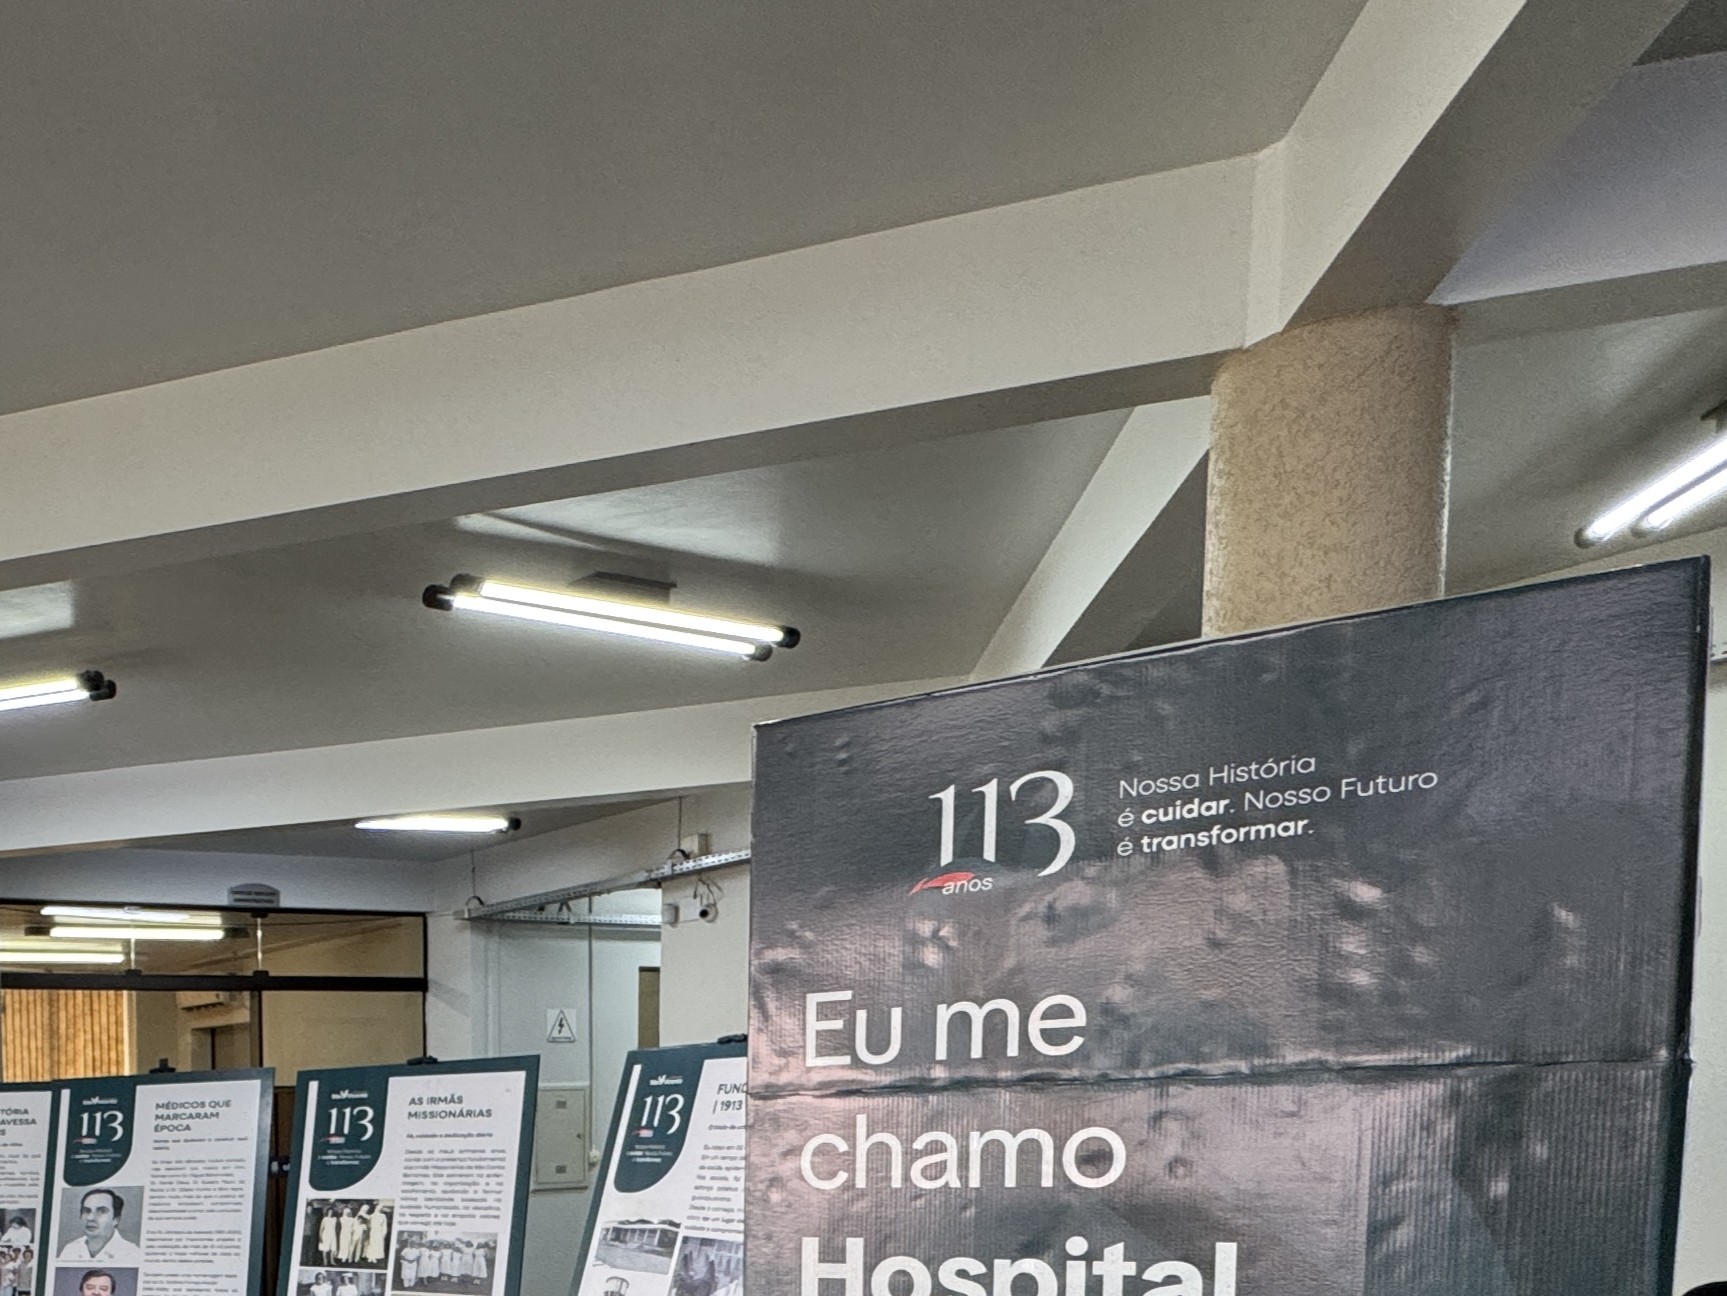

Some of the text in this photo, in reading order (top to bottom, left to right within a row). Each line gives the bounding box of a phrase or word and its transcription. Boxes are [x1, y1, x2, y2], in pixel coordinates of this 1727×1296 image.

[1119, 756, 1316, 798] Nossa História
[1117, 772, 1438, 826] é cuidar. Nosso Futuro
[928, 770, 1076, 877] 113
[1117, 819, 1313, 856] é transformar.
[941, 874, 993, 894] anos
[803, 989, 1086, 1067] Eu me
[155, 1100, 232, 1110] MÉDICOS QUE
[155, 1112, 219, 1121] MARCARAM
[408, 1108, 492, 1120] MISSIONÁRIAS
[409, 1095, 463, 1105] AS IRMÃS
[641, 1094, 685, 1135] 113
[720, 1100, 743, 1111] 1913
[81, 1110, 123, 1141] 113
[154, 1123, 191, 1132] ÉPOCA
[329, 1106, 374, 1141] 113
[800, 1112, 1126, 1191] chamo
